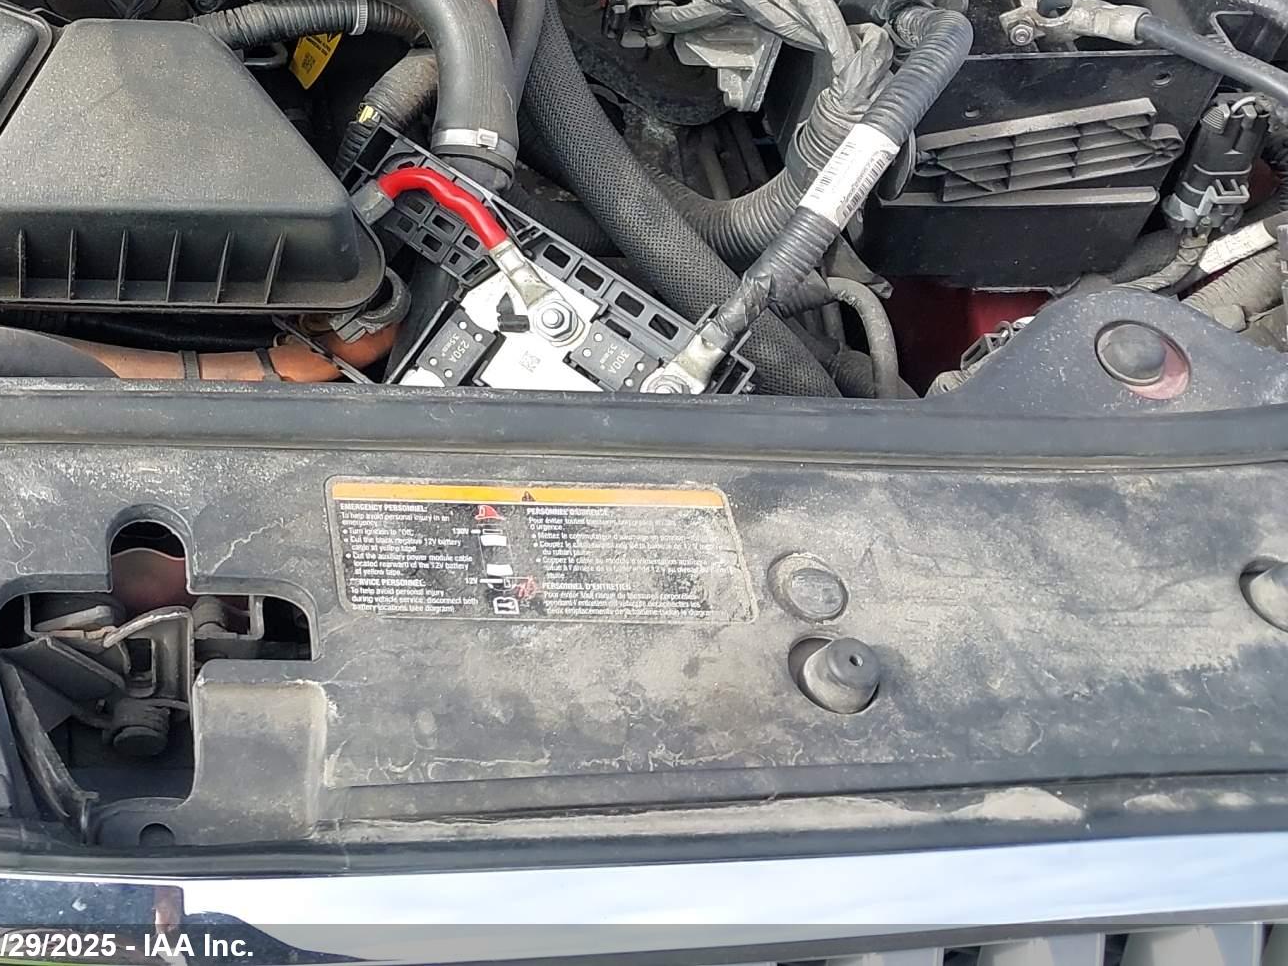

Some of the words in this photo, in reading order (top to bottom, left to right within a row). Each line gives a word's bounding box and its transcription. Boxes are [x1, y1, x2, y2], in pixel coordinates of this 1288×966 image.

[448, 340, 470, 362] 250A
[608, 349, 630, 373] 300A
[340, 503, 383, 511] EMERGENCY
[384, 504, 428, 513] PERSONNEL:
[351, 512, 364, 521] help
[384, 514, 412, 522] personal
[414, 514, 432, 522] injury
[438, 538, 461, 547] battery
[407, 554, 427, 562] power
[429, 554, 453, 562] module
[455, 554, 472, 562] cable
[445, 562, 469, 570] battery
[382, 579, 426, 587] PERSONNEL:
[360, 587, 375, 595] help
[376, 587, 394, 595] avoid
[396, 588, 424, 596] personal
[426, 588, 444, 597] injury
[352, 595, 373, 603] during
[463, 596, 478, 604] both
[352, 603, 375, 611] battery
